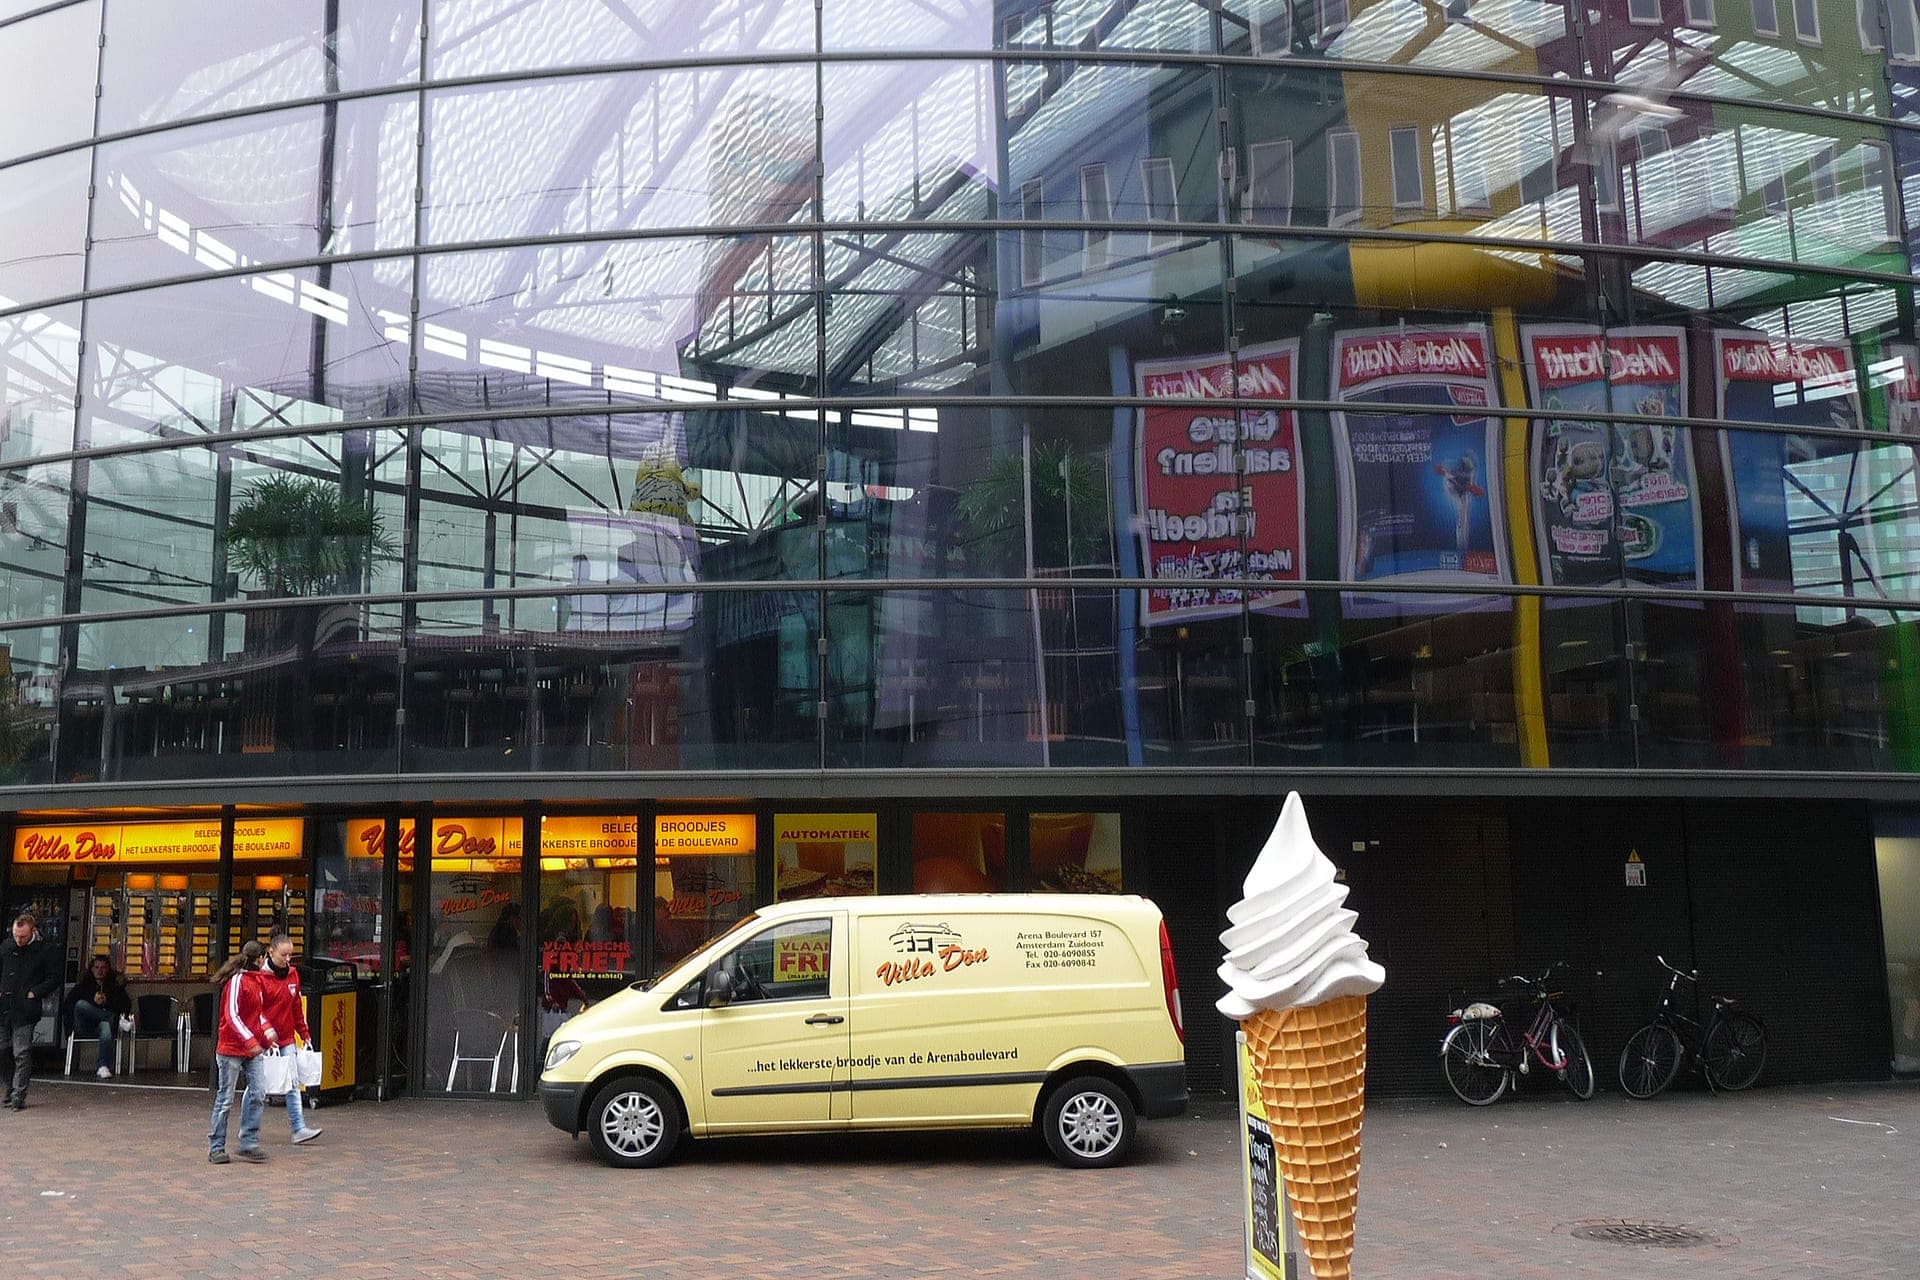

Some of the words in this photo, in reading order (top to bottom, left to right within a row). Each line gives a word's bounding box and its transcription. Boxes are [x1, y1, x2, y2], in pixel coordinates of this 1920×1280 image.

[601, 823, 638, 833] BELEG
[661, 821, 726, 832] BROODJES
[437, 824, 496, 855] Don
[781, 830, 871, 839] AUTOMATIEK
[24, 832, 71, 860] Villa
[75, 831, 116, 860] Don
[140, 845, 181, 854] LEKKERSTE
[183, 844, 216, 853] BROODJE
[245, 842, 291, 850] BOULEVARD
[542, 839, 587, 848] KKERSTE
[590, 839, 637, 848] BROODJE
[662, 839, 675, 847] DE
[678, 838, 739, 847] BOULEVARD
[1017, 932, 1043, 940] Arena
[1045, 931, 1087, 939] Boulevard
[1090, 930, 1102, 938] 157
[1016, 941, 1065, 950] Amsterdam
[1068, 940, 1105, 948] Zuidoost
[1025, 951, 1039, 959] Tel.
[1043, 949, 1096, 959] 020-6090855
[542, 951, 631, 972] FRIET
[876, 956, 936, 986] Villa
[938, 945, 989, 972] Don
[1025, 961, 1041, 969] Fax
[1043, 959, 1097, 968] 020-6090842
[779, 1058, 833, 1071] lekkerste
[835, 1055, 881, 1069] broodje
[885, 1055, 905, 1066] van
[909, 1052, 923, 1064] de
[927, 1047, 1018, 1064] Arenaboulevard
